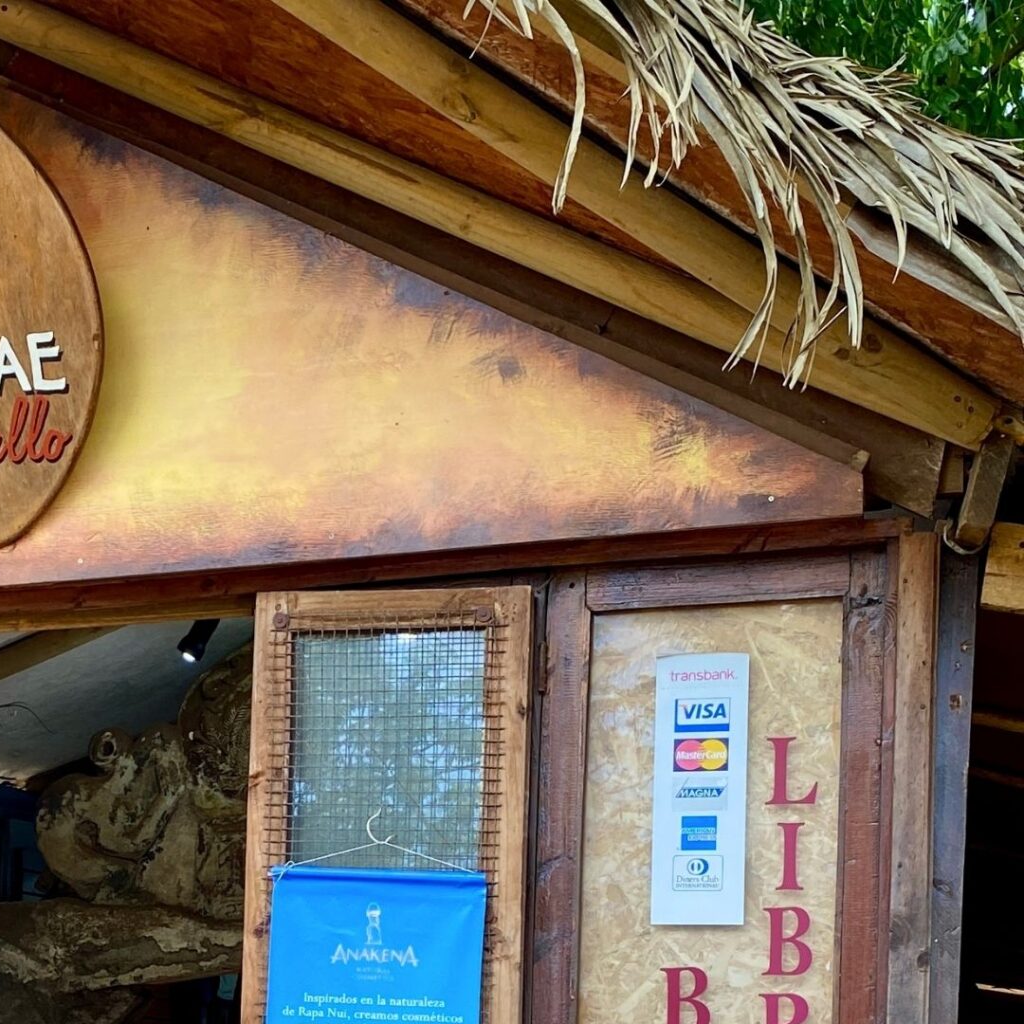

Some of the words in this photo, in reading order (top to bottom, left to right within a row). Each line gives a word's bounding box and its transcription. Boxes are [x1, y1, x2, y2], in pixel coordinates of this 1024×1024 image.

[680, 702, 727, 719] VISA
[675, 749, 727, 762] MasterCard
[678, 787, 721, 798] MAGNA
[701, 874, 719, 883] Club
[331, 944, 419, 967] ANAKENA
[304, 992, 357, 1007] Inspirados
[360, 996, 373, 1005] en
[377, 995, 386, 1006] la
[390, 996, 445, 1009] naturaleza
[282, 1007, 295, 1016] de
[298, 1007, 325, 1020] Rapa
[327, 1008, 351, 1020] Nui,
[354, 1012, 399, 1021] creamos
[401, 1011, 464, 1024] cosméticos
